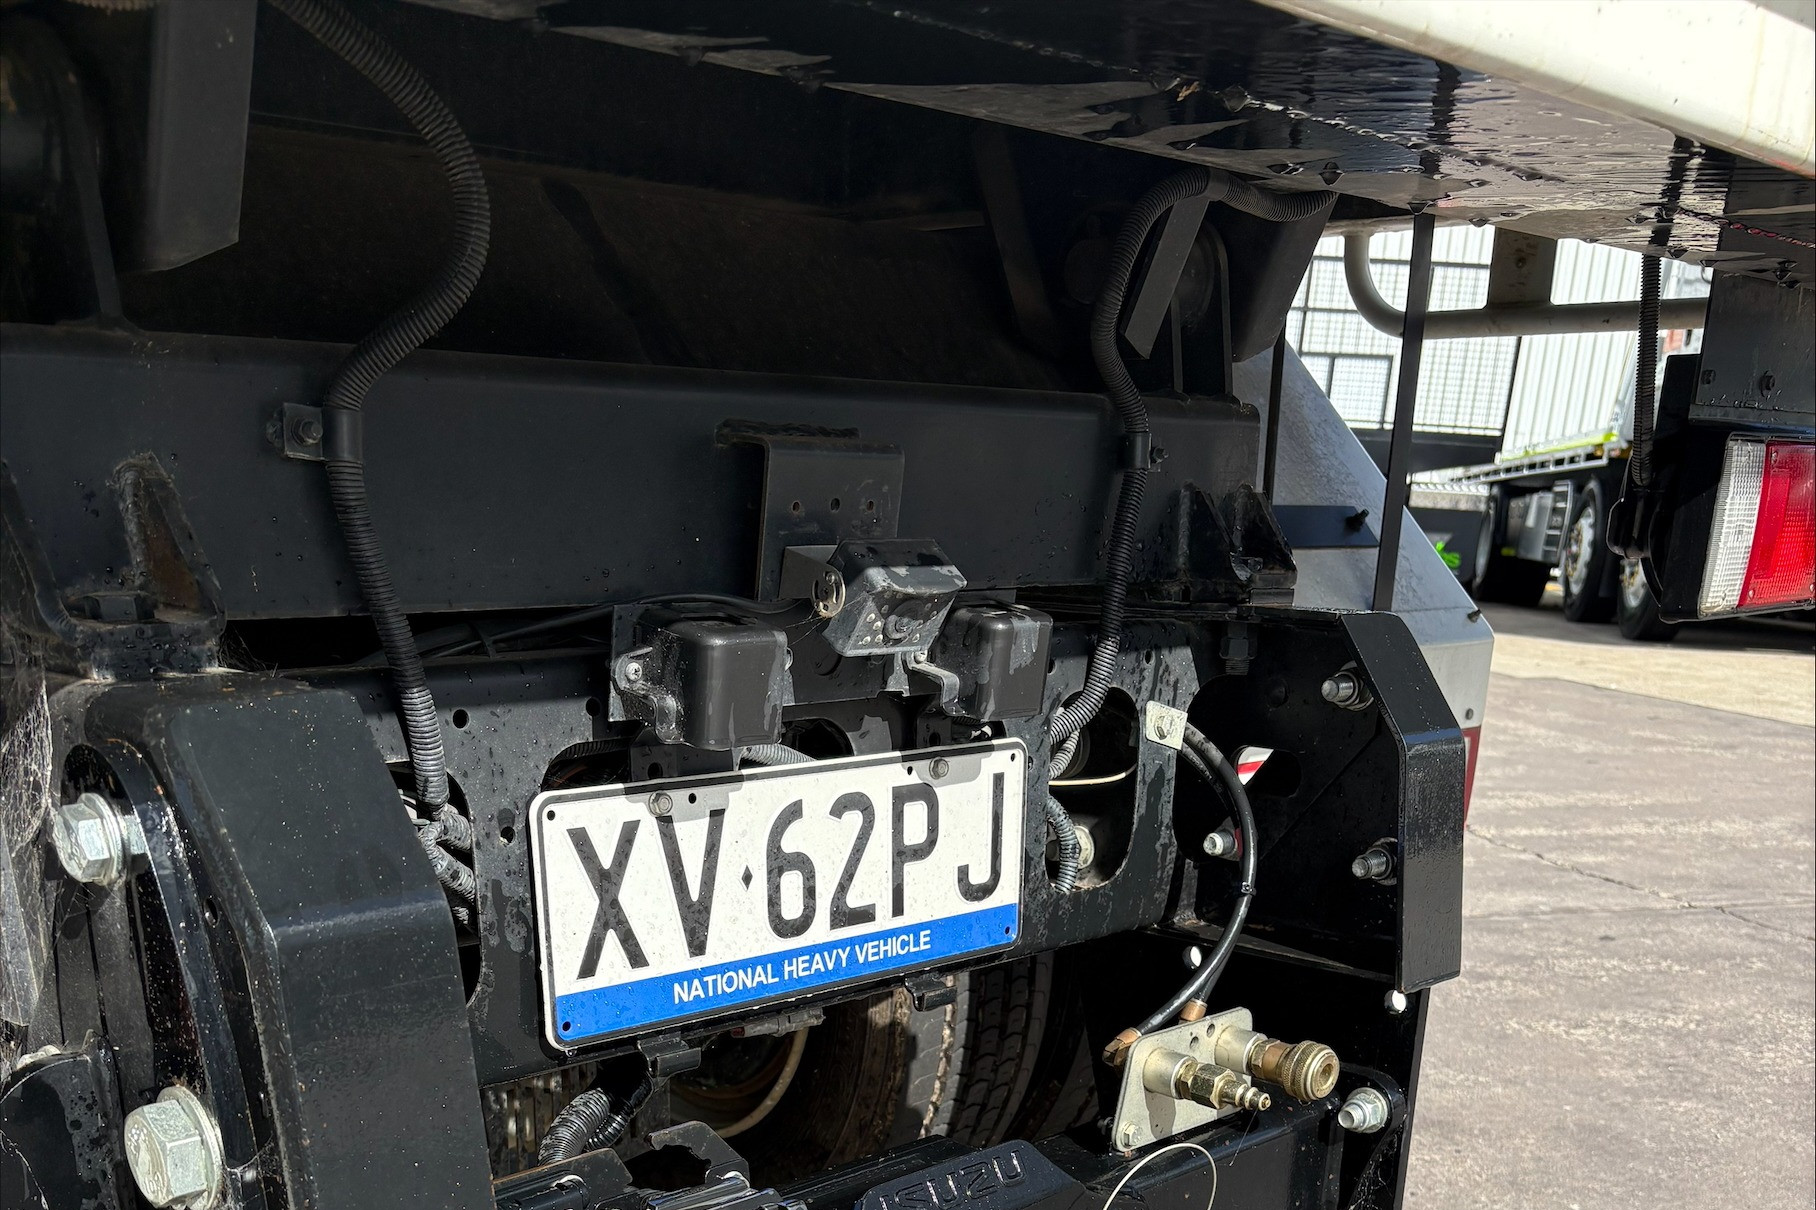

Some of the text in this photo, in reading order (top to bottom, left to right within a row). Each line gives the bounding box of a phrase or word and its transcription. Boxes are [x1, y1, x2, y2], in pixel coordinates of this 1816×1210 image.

[673, 929, 932, 1005] NATIONAL HEAVY VEHICLE
